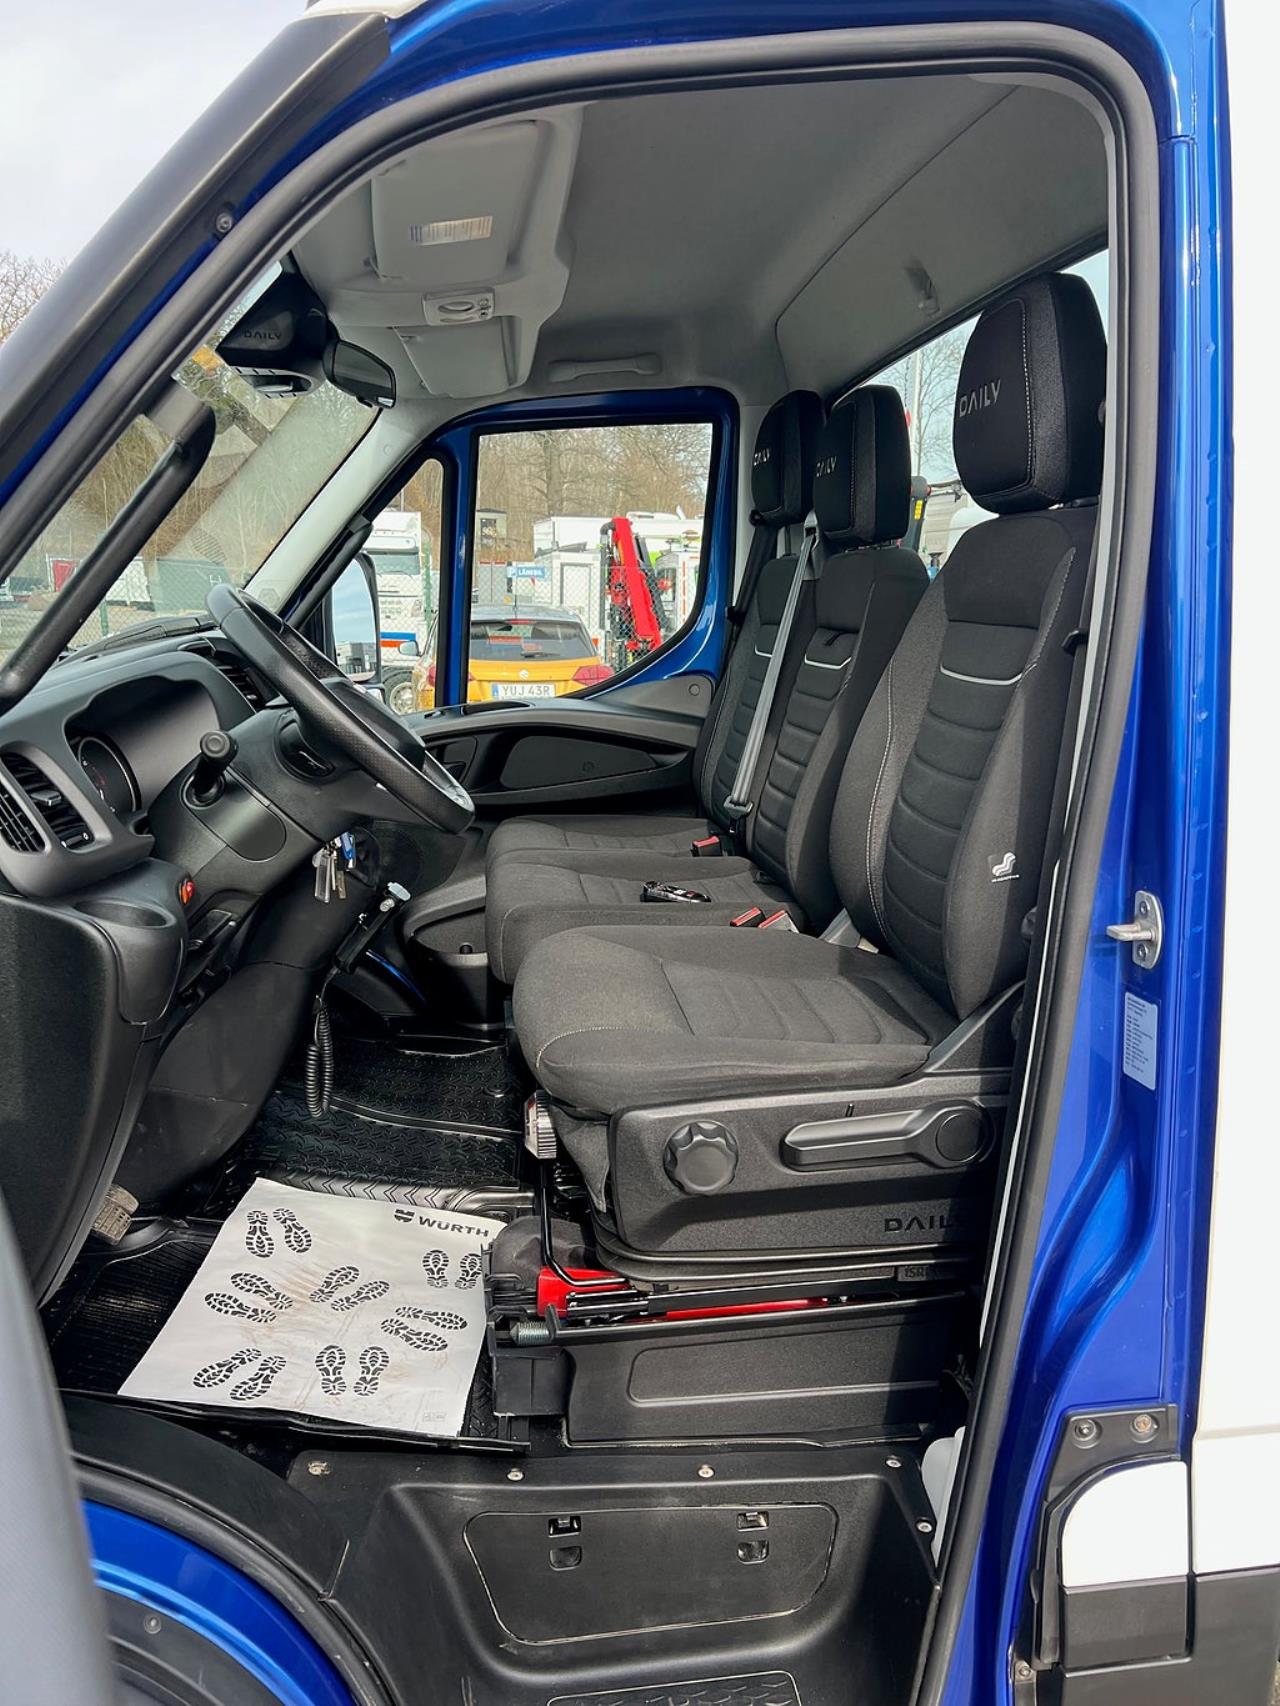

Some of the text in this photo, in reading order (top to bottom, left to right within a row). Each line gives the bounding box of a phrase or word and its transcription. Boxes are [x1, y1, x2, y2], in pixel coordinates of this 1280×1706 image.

[959, 379, 1001, 417] DAILY
[503, 685, 550, 696] YUJ 43R
